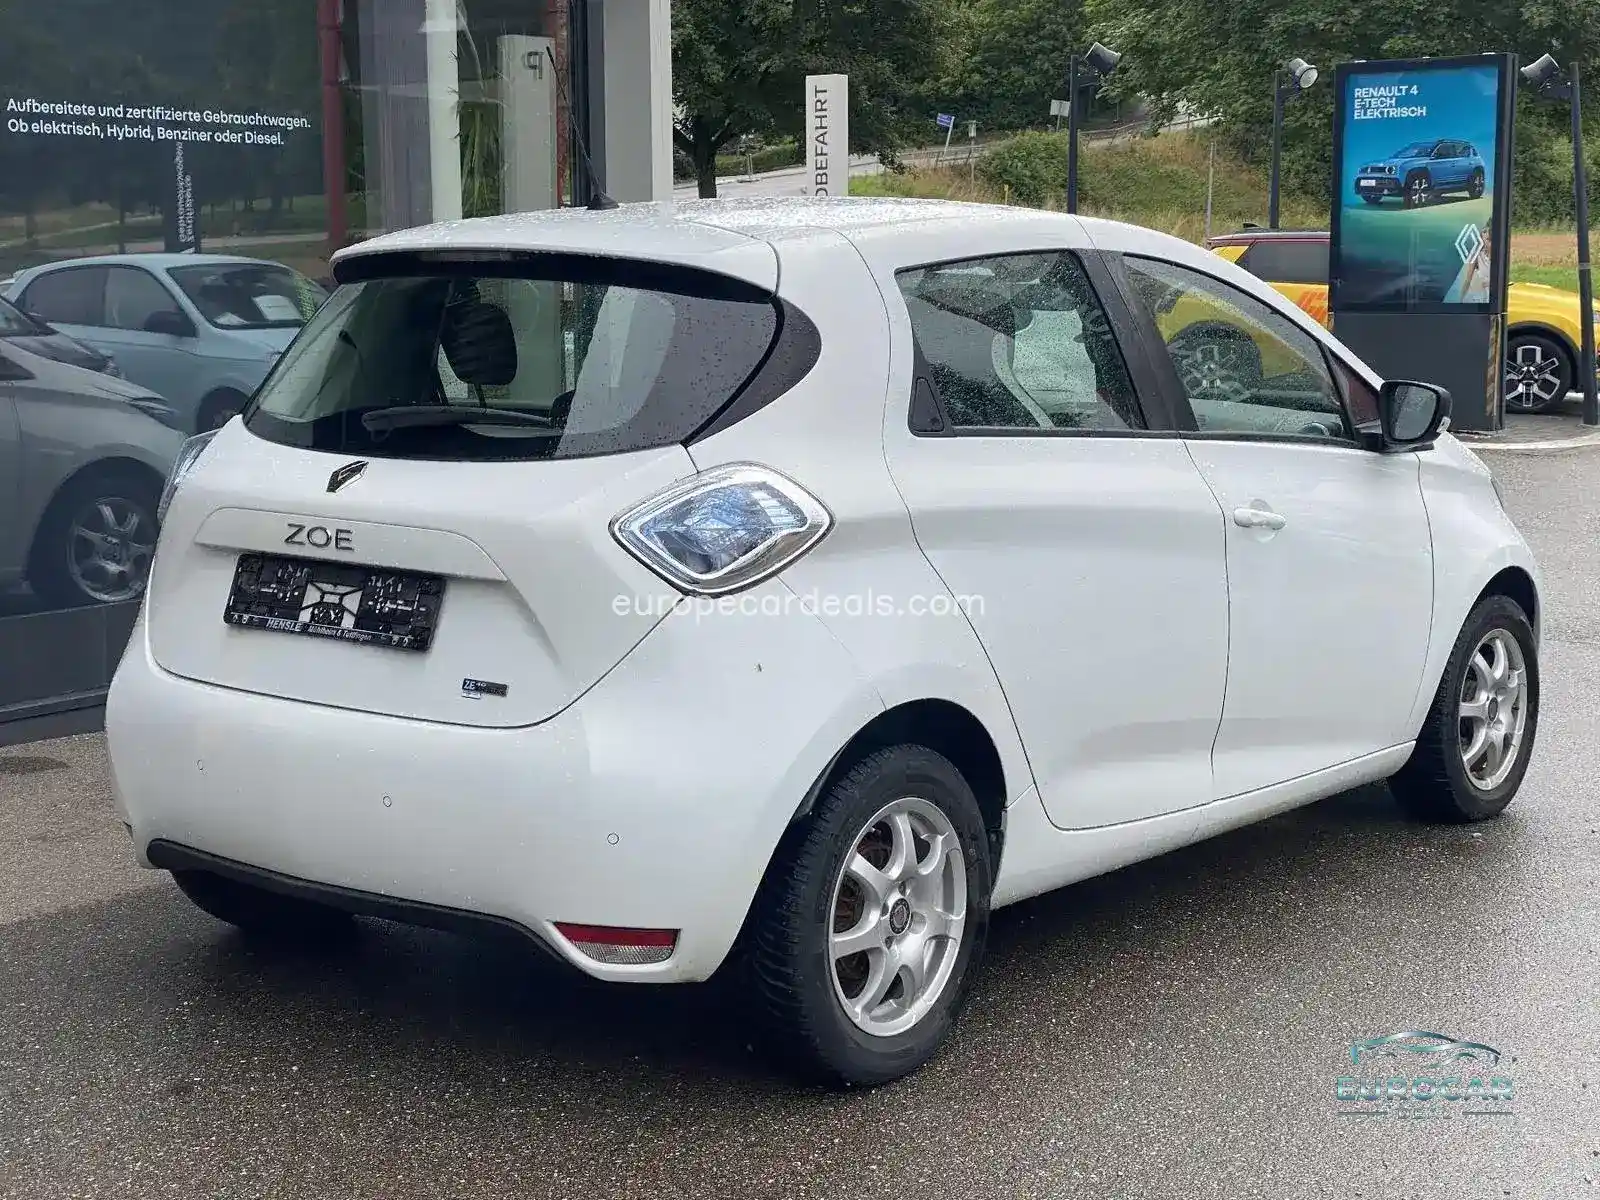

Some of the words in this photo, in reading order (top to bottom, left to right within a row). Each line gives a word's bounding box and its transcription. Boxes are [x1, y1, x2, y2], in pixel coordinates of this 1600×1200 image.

[1354, 85, 1408, 98] RENAULT
[1409, 84, 1419, 95] 4
[1354, 97, 1396, 109] E-TECH
[6, 98, 96, 116] Aufbereitete
[98, 105, 124, 118] und
[126, 105, 200, 122] zertifizierte
[203, 110, 311, 130] Gebrauchtwagen.
[1354, 106, 1427, 120] ELEKTRISCH
[7, 118, 29, 133] Ob
[31, 119, 104, 139] elektrisch,
[106, 124, 154, 141] Hybrid,
[157, 126, 212, 141] Benziner
[214, 130, 242, 143] oder
[244, 131, 284, 145] Diesel.
[284, 523, 354, 551] ZOE
[266, 618, 302, 632] HENSLE
